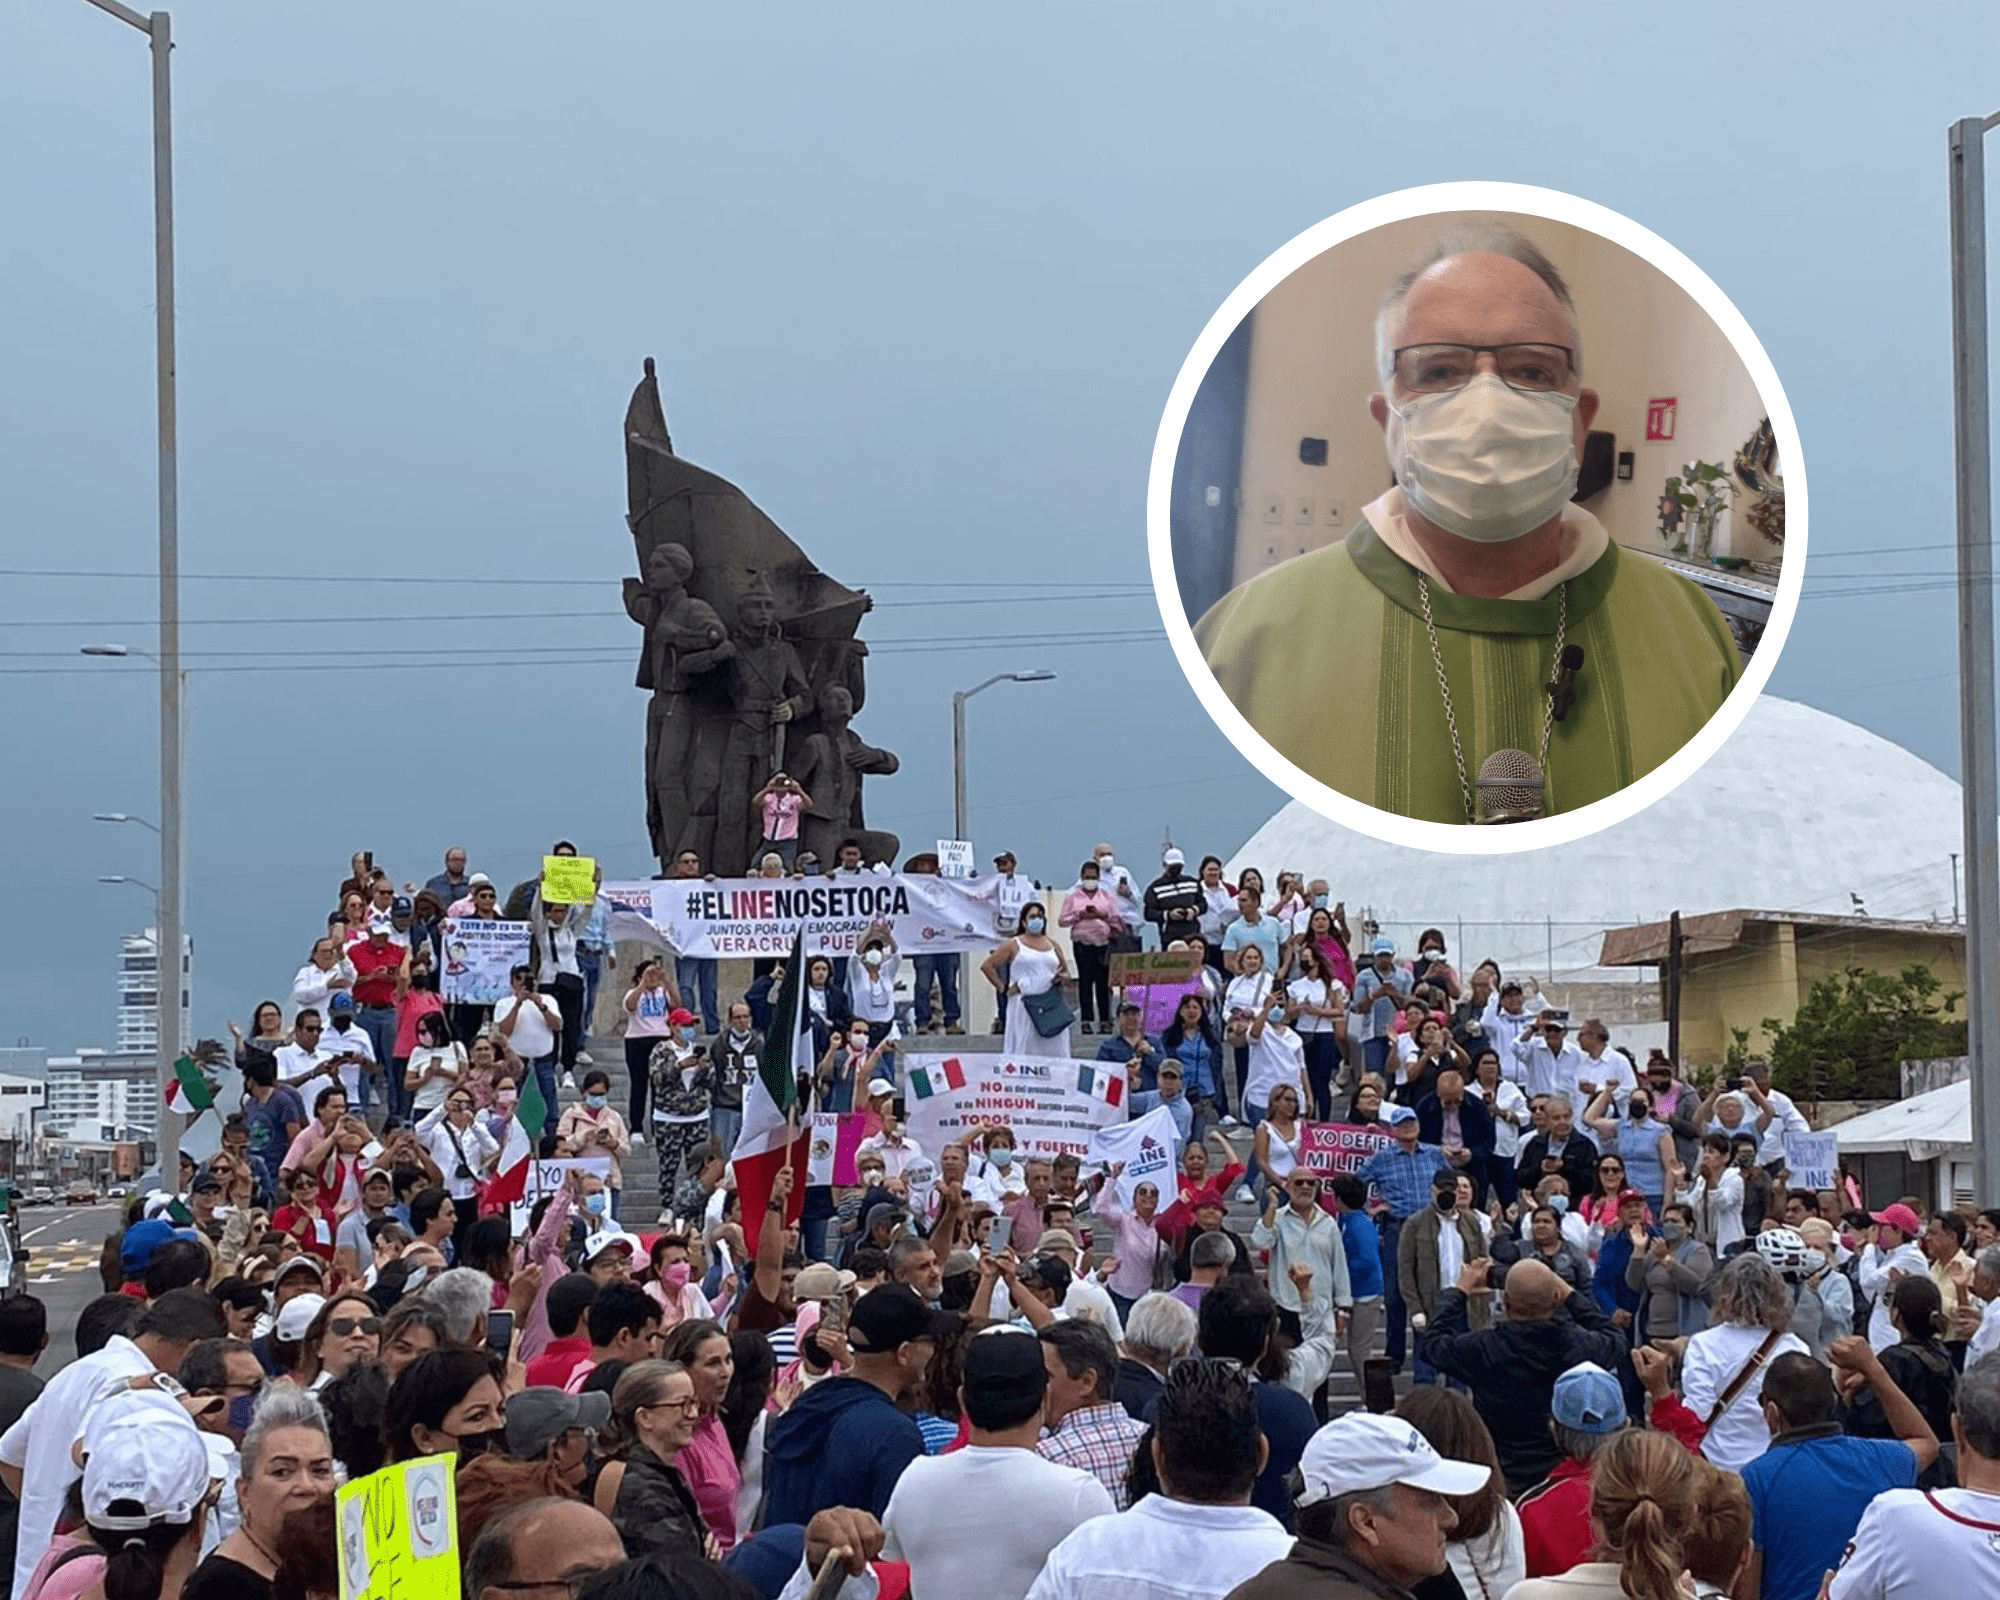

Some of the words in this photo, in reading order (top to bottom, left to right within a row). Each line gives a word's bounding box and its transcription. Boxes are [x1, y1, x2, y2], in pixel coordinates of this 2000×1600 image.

[687, 886, 910, 920] #ELINENOSETOCA
[460, 921, 480, 930] ESTE
[483, 922, 497, 931] NO
[706, 923, 751, 936] JUNTOS
[755, 923, 779, 935] POR
[781, 922, 796, 934] LA
[710, 936, 796, 952] VERACRU
[726, 1053, 735, 1069] I
[1020, 1065, 1050, 1075] INE
[980, 1081, 1002, 1092] NO
[1313, 1130, 1337, 1147] YO
[1022, 1140, 1030, 1150] Y
[1036, 1140, 1089, 1155] FUERTES
[1139, 1146, 1167, 1163] INE
[1306, 1151, 1331, 1169] MI
[541, 1166, 562, 1186] YO
[361, 1475, 396, 1548] NO
